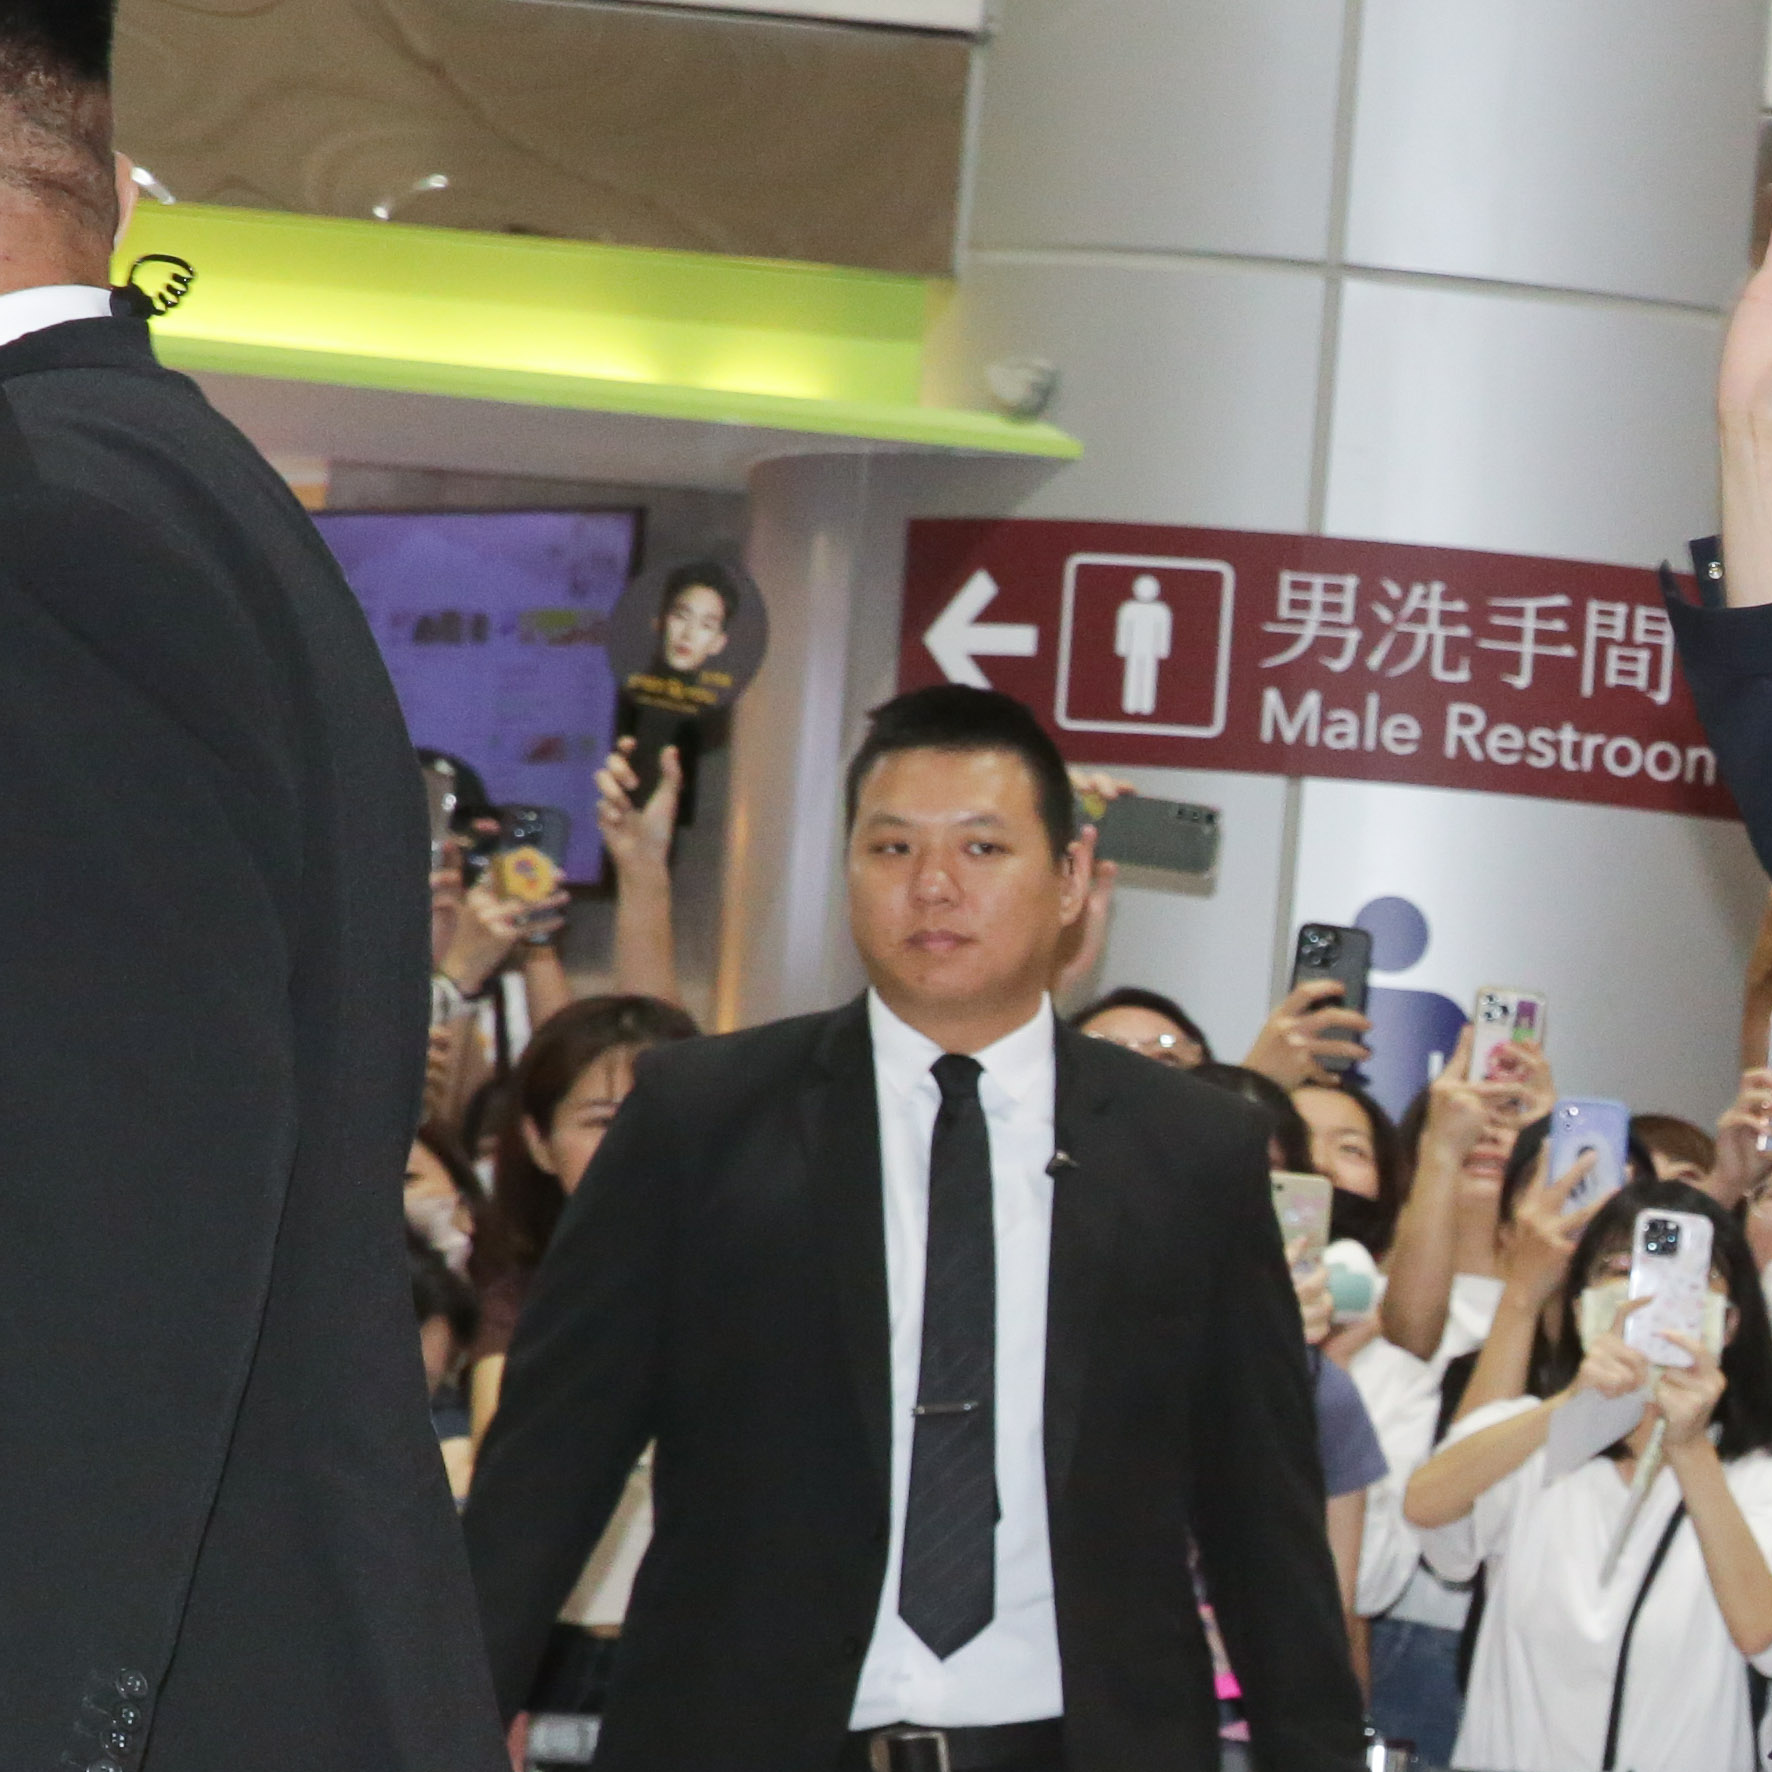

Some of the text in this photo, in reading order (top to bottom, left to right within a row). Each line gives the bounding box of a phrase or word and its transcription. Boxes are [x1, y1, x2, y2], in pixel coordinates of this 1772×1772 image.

[1260, 568, 1675, 706] 男洗手間
[1259, 687, 1423, 756] Male
